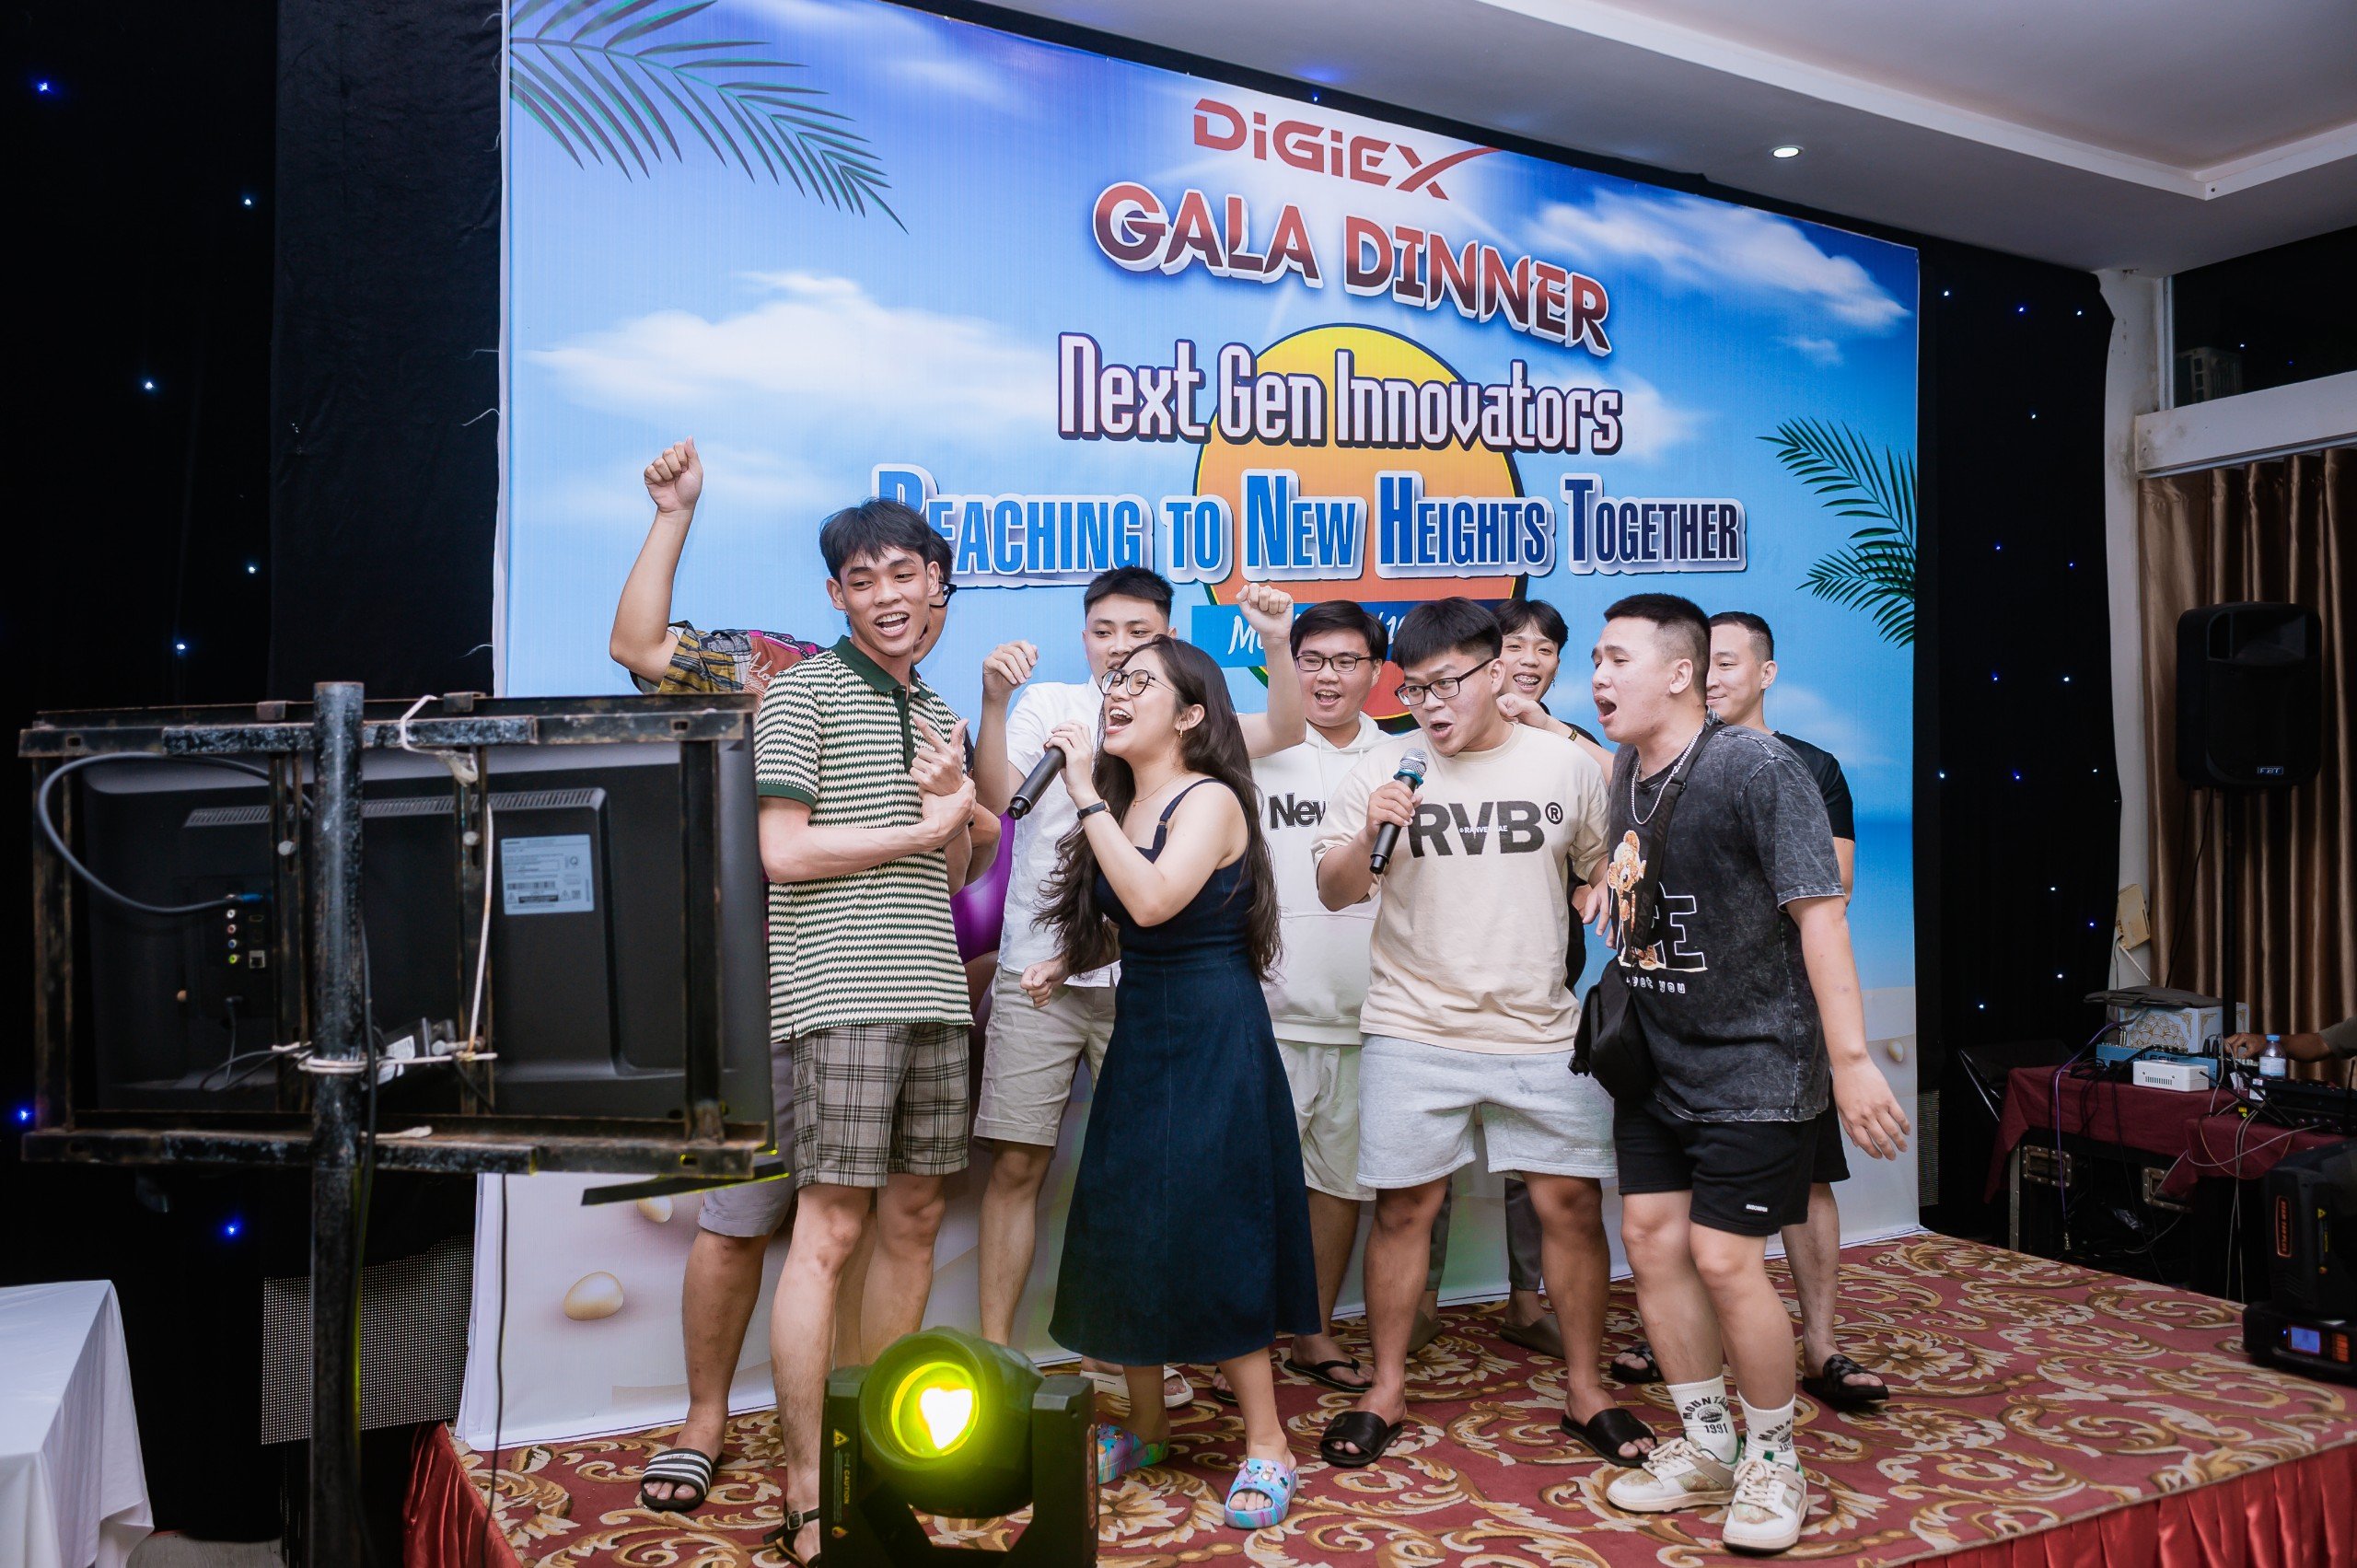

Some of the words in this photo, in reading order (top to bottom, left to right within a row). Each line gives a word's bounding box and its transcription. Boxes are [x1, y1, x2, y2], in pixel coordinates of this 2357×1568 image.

[1093, 181, 1323, 288] GALA
[1344, 215, 1611, 356] DINNER
[1059, 332, 1211, 444] Next
[1217, 343, 1327, 447] Gen
[1335, 349, 1622, 455] Innovators
[1245, 472, 1360, 572] NEW
[1378, 474, 1550, 571] HEIGHTS
[1562, 477, 1742, 567] TOGETHER
[1703, 1423, 1729, 1434] 1991
